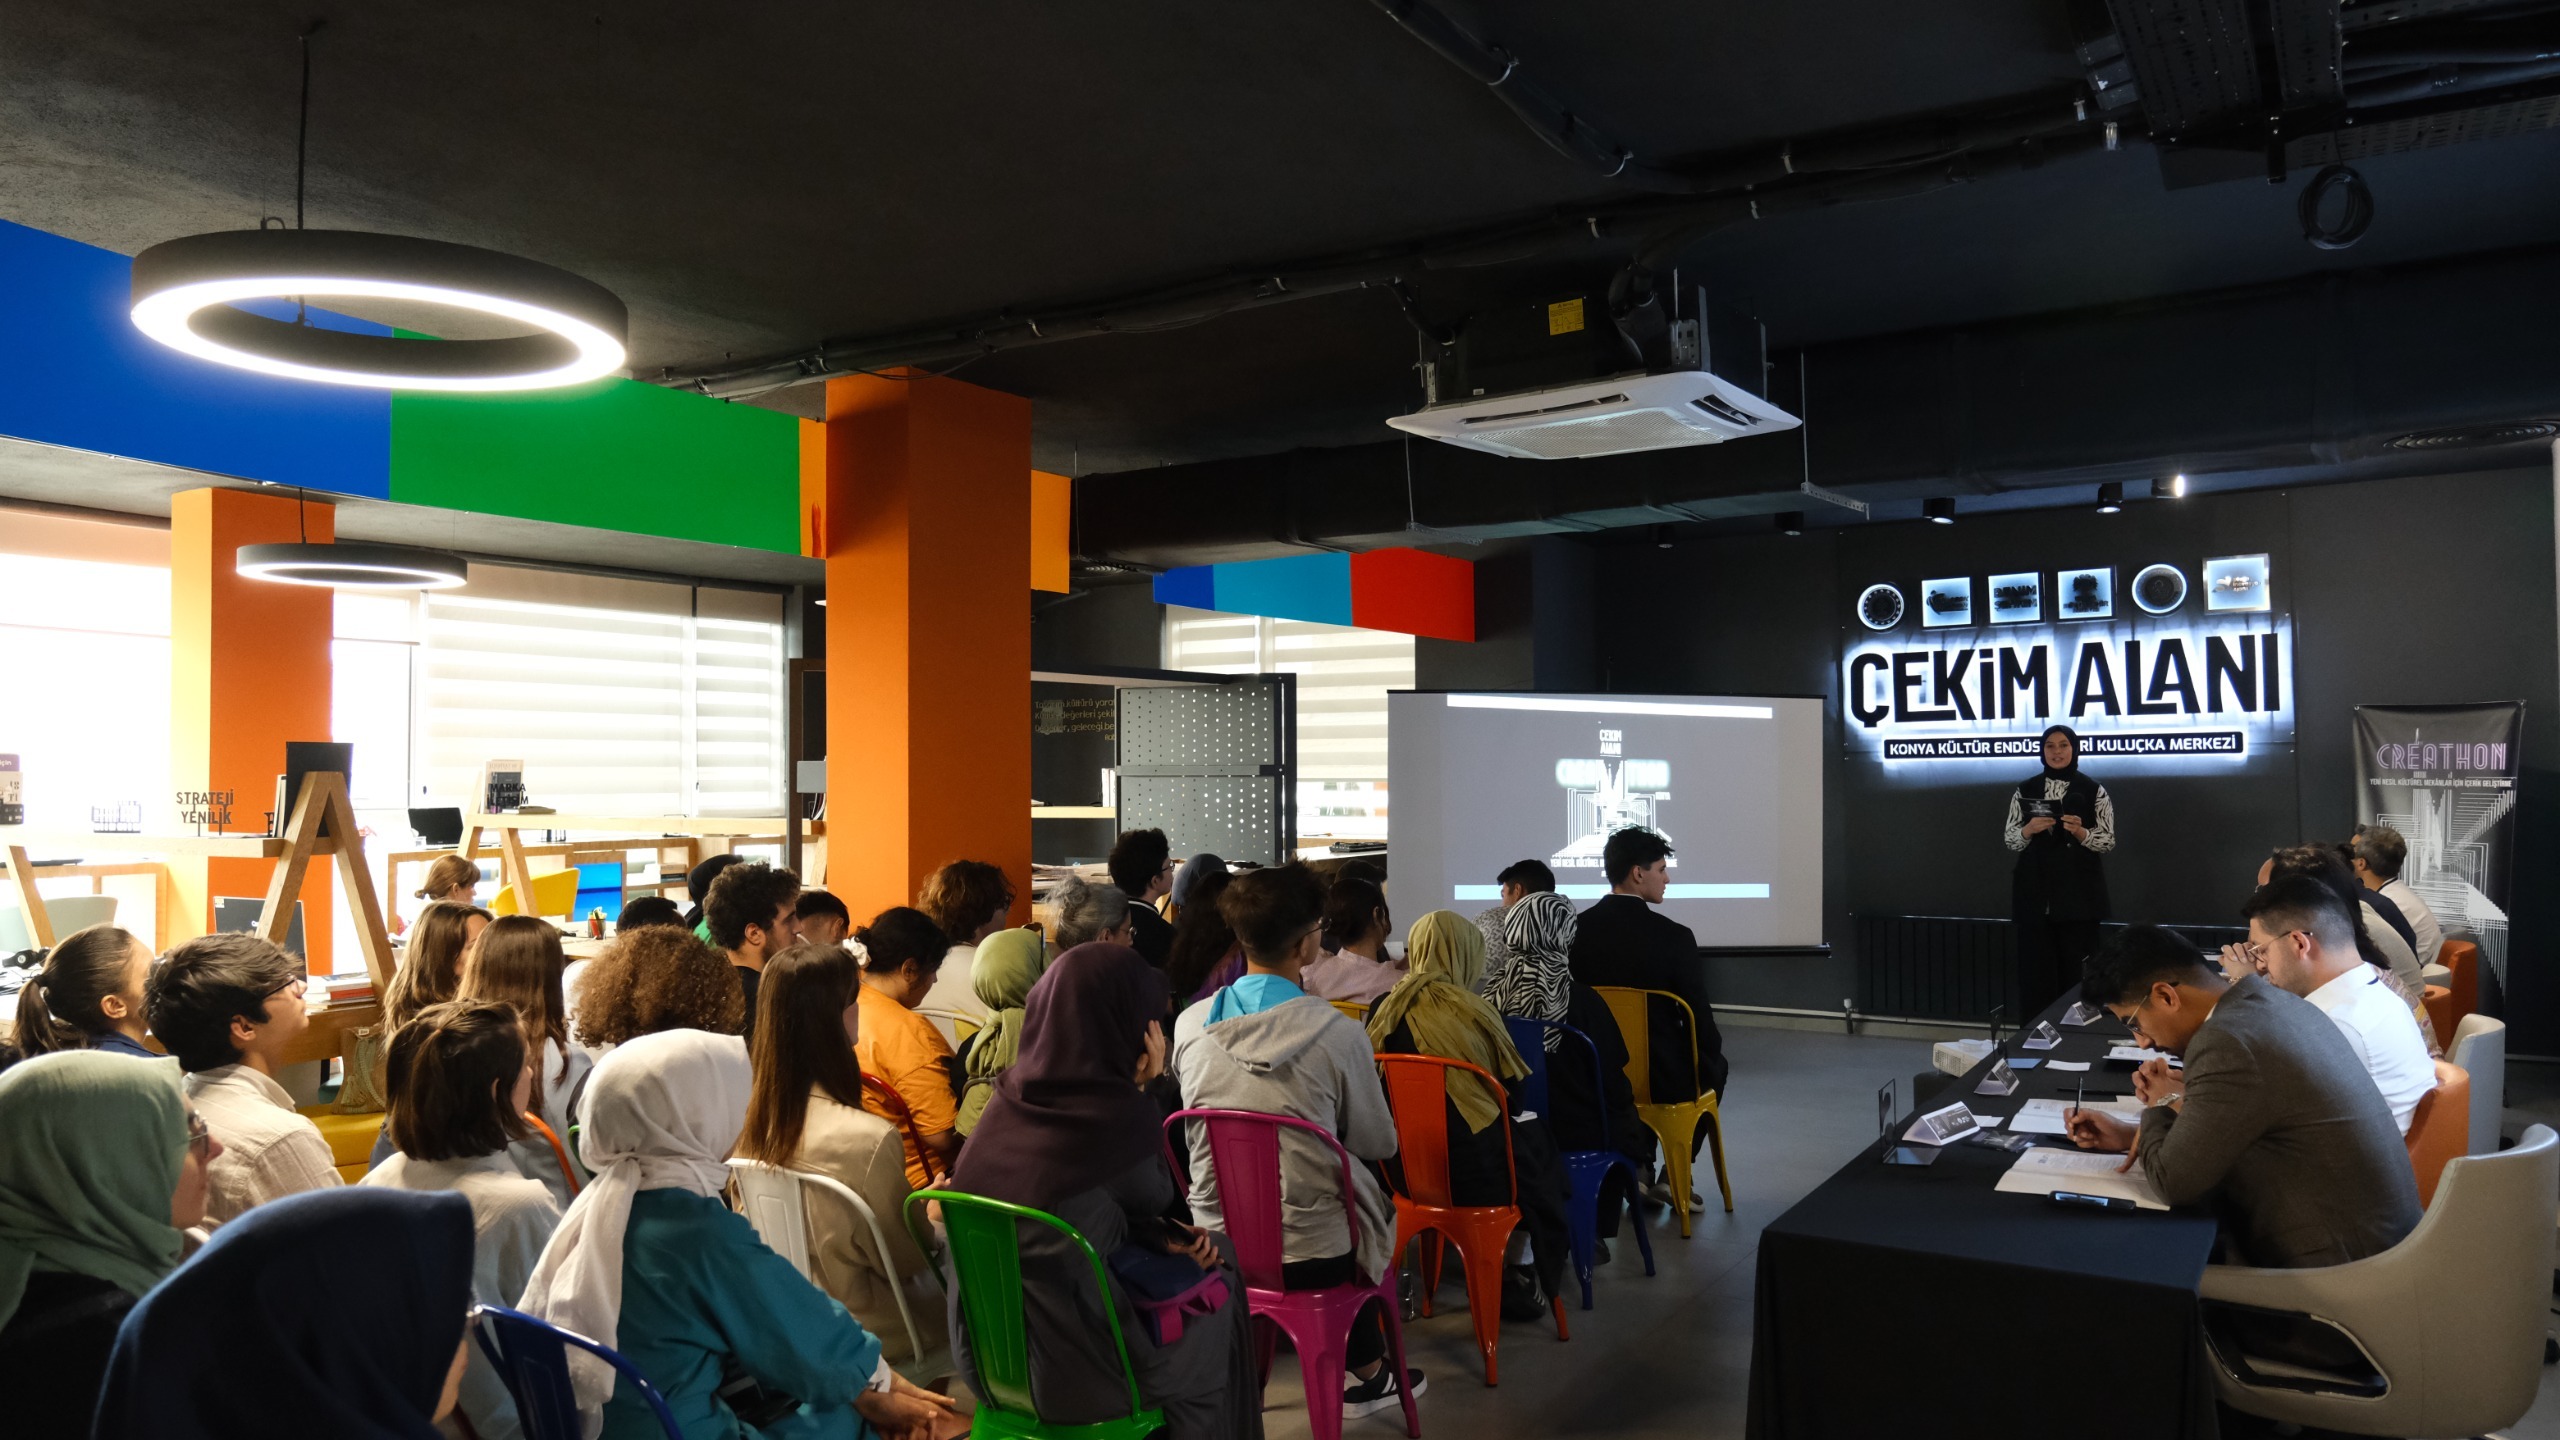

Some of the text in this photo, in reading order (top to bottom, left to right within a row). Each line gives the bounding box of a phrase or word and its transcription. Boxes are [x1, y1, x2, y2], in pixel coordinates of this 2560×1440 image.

[1850, 633, 2281, 728] ÇEKİM ALANI
[1889, 743, 1935, 755] KONYA
[1938, 740, 1991, 755] KÜLTÜR
[2097, 737, 2166, 753] KULUÇKA
[2169, 735, 2236, 750] MERKEZİ
[2376, 743, 2507, 770] CREATHON
[176, 788, 234, 805] STRATEJİ
[489, 783, 526, 792] MARKA
[181, 808, 232, 824] YENİLİK
